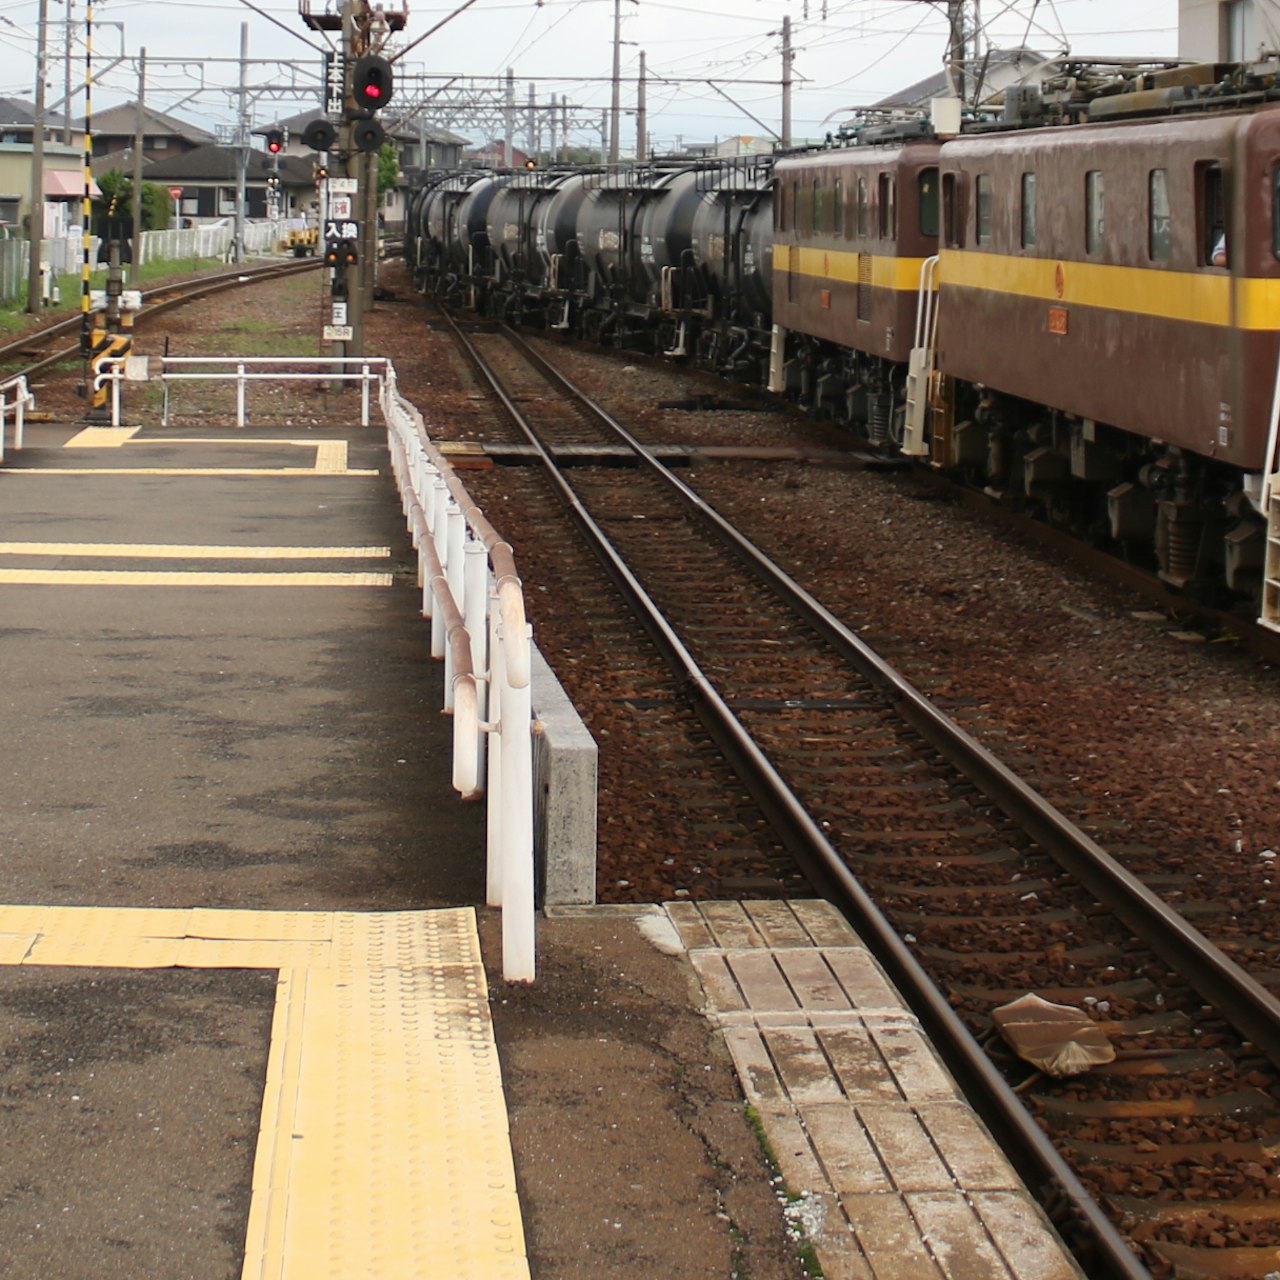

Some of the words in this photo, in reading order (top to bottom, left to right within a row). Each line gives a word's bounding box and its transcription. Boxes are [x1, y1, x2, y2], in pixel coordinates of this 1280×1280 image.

[328, 52, 344, 114] 上本下出
[325, 222, 358, 238] 入換
